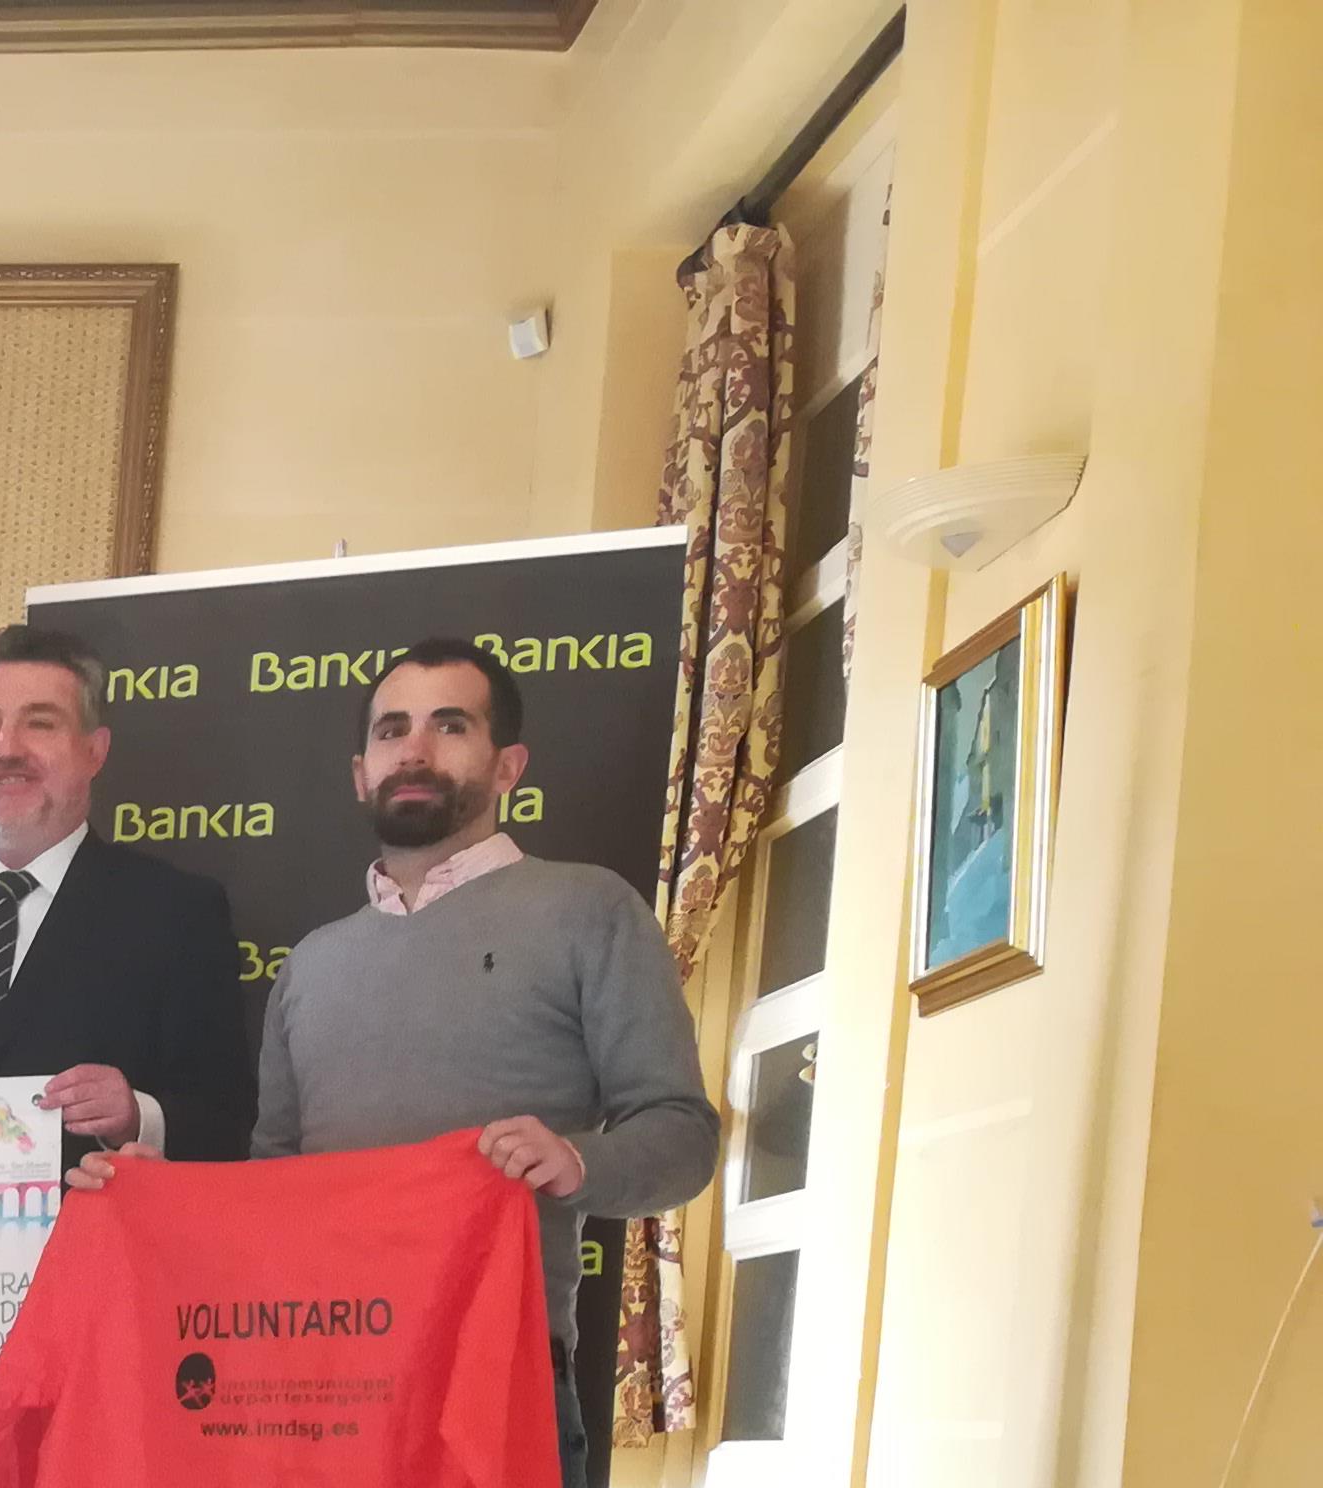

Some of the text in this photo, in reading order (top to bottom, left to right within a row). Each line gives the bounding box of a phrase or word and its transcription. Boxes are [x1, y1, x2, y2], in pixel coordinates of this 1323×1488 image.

[107, 664, 199, 702] nkia
[113, 801, 274, 842] Bankia
[176, 1298, 393, 1341] VOLUNTARIO
[201, 1419, 360, 1442] www.imdsg.es
